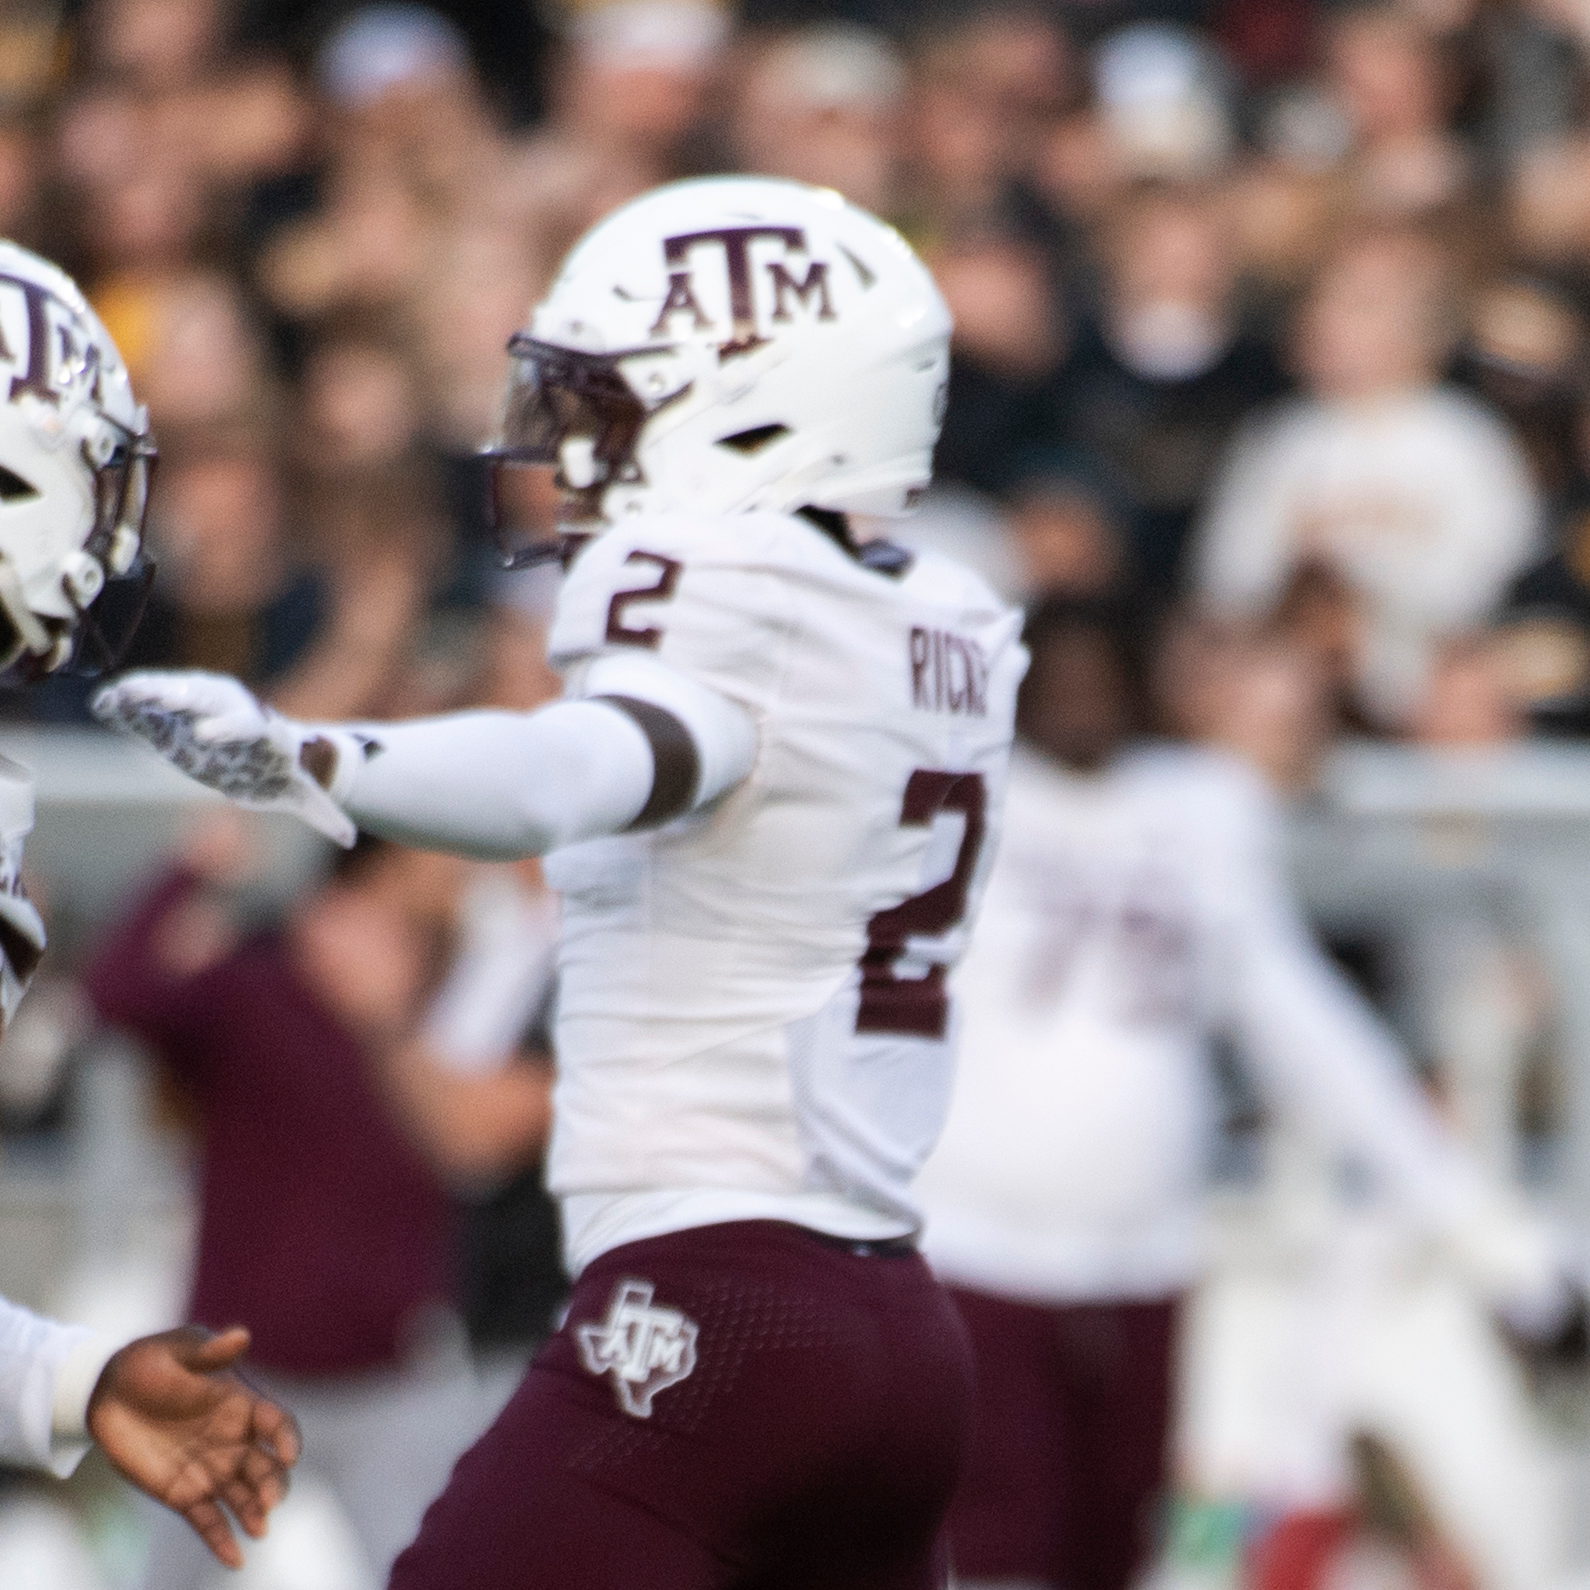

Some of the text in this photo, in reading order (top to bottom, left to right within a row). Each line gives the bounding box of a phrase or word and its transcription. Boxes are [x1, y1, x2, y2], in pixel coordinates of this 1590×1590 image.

[605, 550, 682, 649] 2
[911, 626, 988, 716] RICK
[855, 768, 987, 1041] 2
